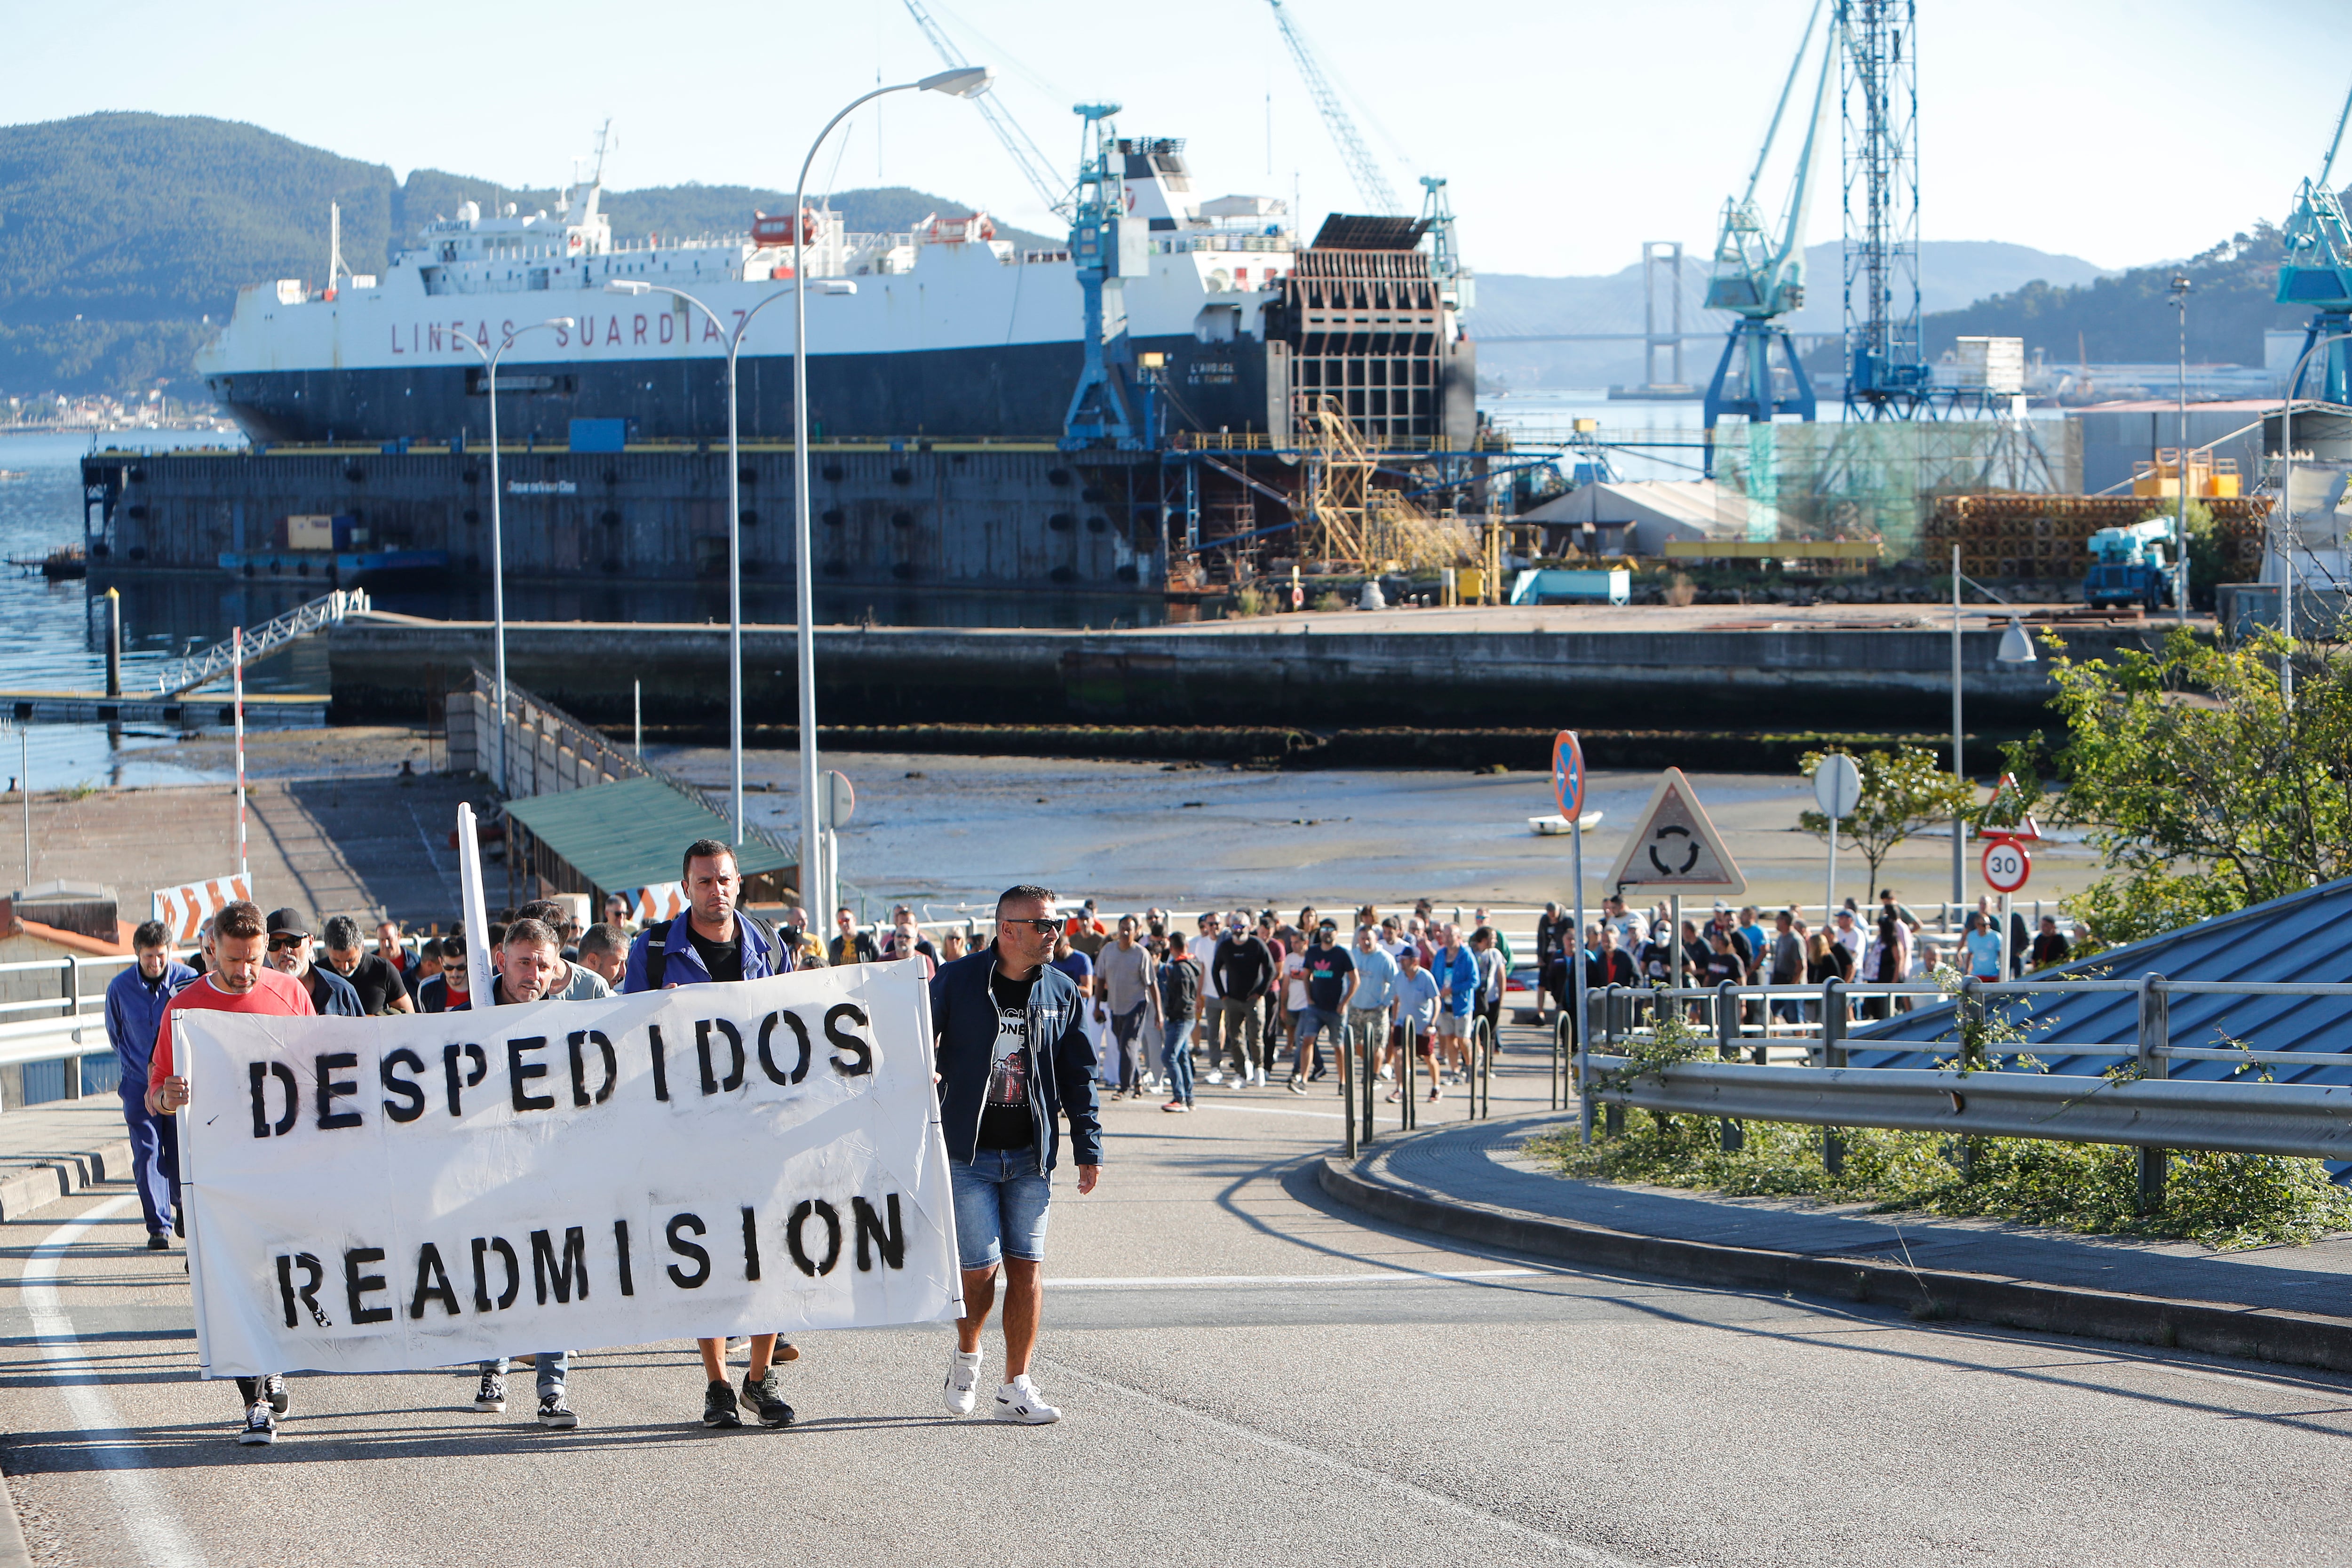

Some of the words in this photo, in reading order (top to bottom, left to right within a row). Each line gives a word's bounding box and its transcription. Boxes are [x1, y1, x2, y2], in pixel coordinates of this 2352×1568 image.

[392, 320, 515, 353] LINEAS
[556, 309, 747, 347] SUARDIAZ
[1991, 857, 2016, 874] 30
[250, 1003, 873, 1138] DESPEDIDOS
[276, 1193, 905, 1329] READMISION
